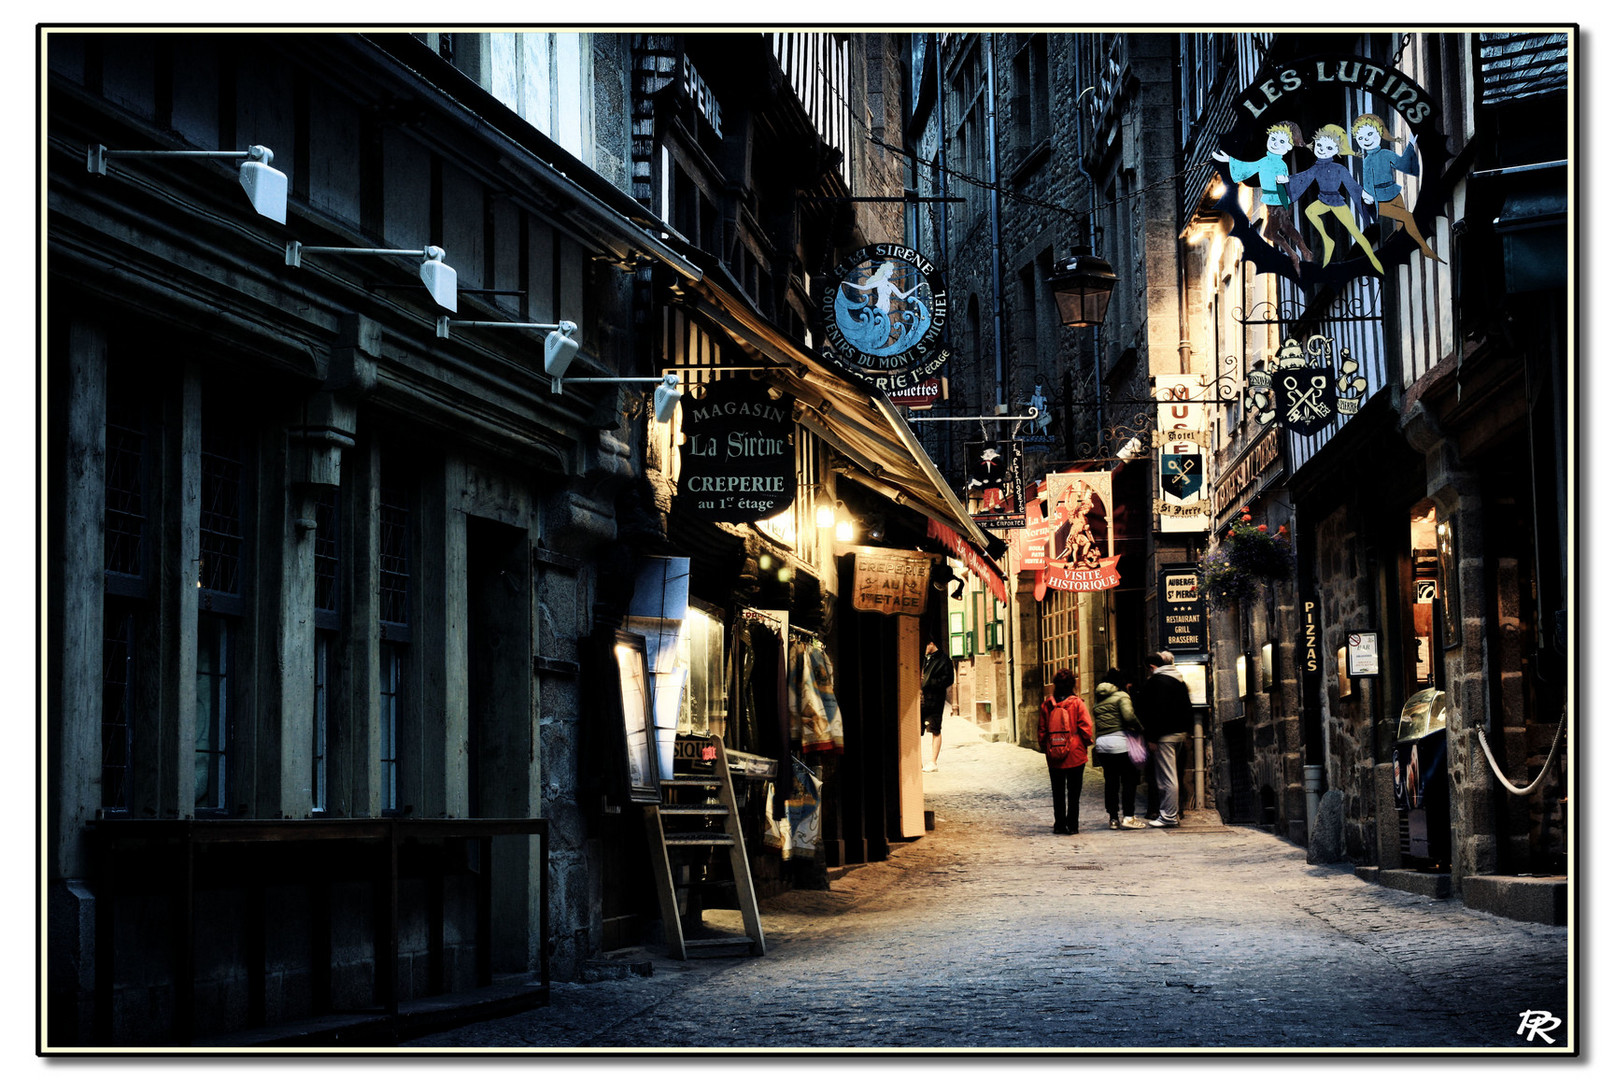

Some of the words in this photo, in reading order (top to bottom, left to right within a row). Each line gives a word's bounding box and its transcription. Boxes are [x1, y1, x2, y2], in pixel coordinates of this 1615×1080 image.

[1243, 69, 1302, 119] LES
[1316, 61, 1431, 124] LUTINS
[876, 244, 934, 276] SIRENE
[822, 286, 856, 359] SOUVENIRS
[857, 354, 876, 368] DU
[879, 350, 916, 368] MONT
[924, 289, 947, 344] MICHEL
[692, 401, 785, 423] MAGASIN
[688, 433, 717, 458] La
[725, 430, 784, 463] Sirène
[687, 476, 785, 493] CREPERIE
[698, 500, 715, 509] au
[738, 497, 774, 512] étage
[1174, 505, 1201, 515] Pierre
[858, 562, 926, 577] CREPERIE
[1064, 568, 1103, 580] VISITE
[882, 580, 900, 590] AU
[1048, 575, 1118, 591] HISTORIQUE
[1168, 578, 1195, 587] AUBERGE
[875, 594, 920, 607] ETAGE
[1166, 614, 1200, 624] RESTAURANT
[1174, 625, 1191, 634] GRILL
[1304, 601, 1318, 672] PIZZAS
[1168, 635, 1199, 644] BRASSERIE
